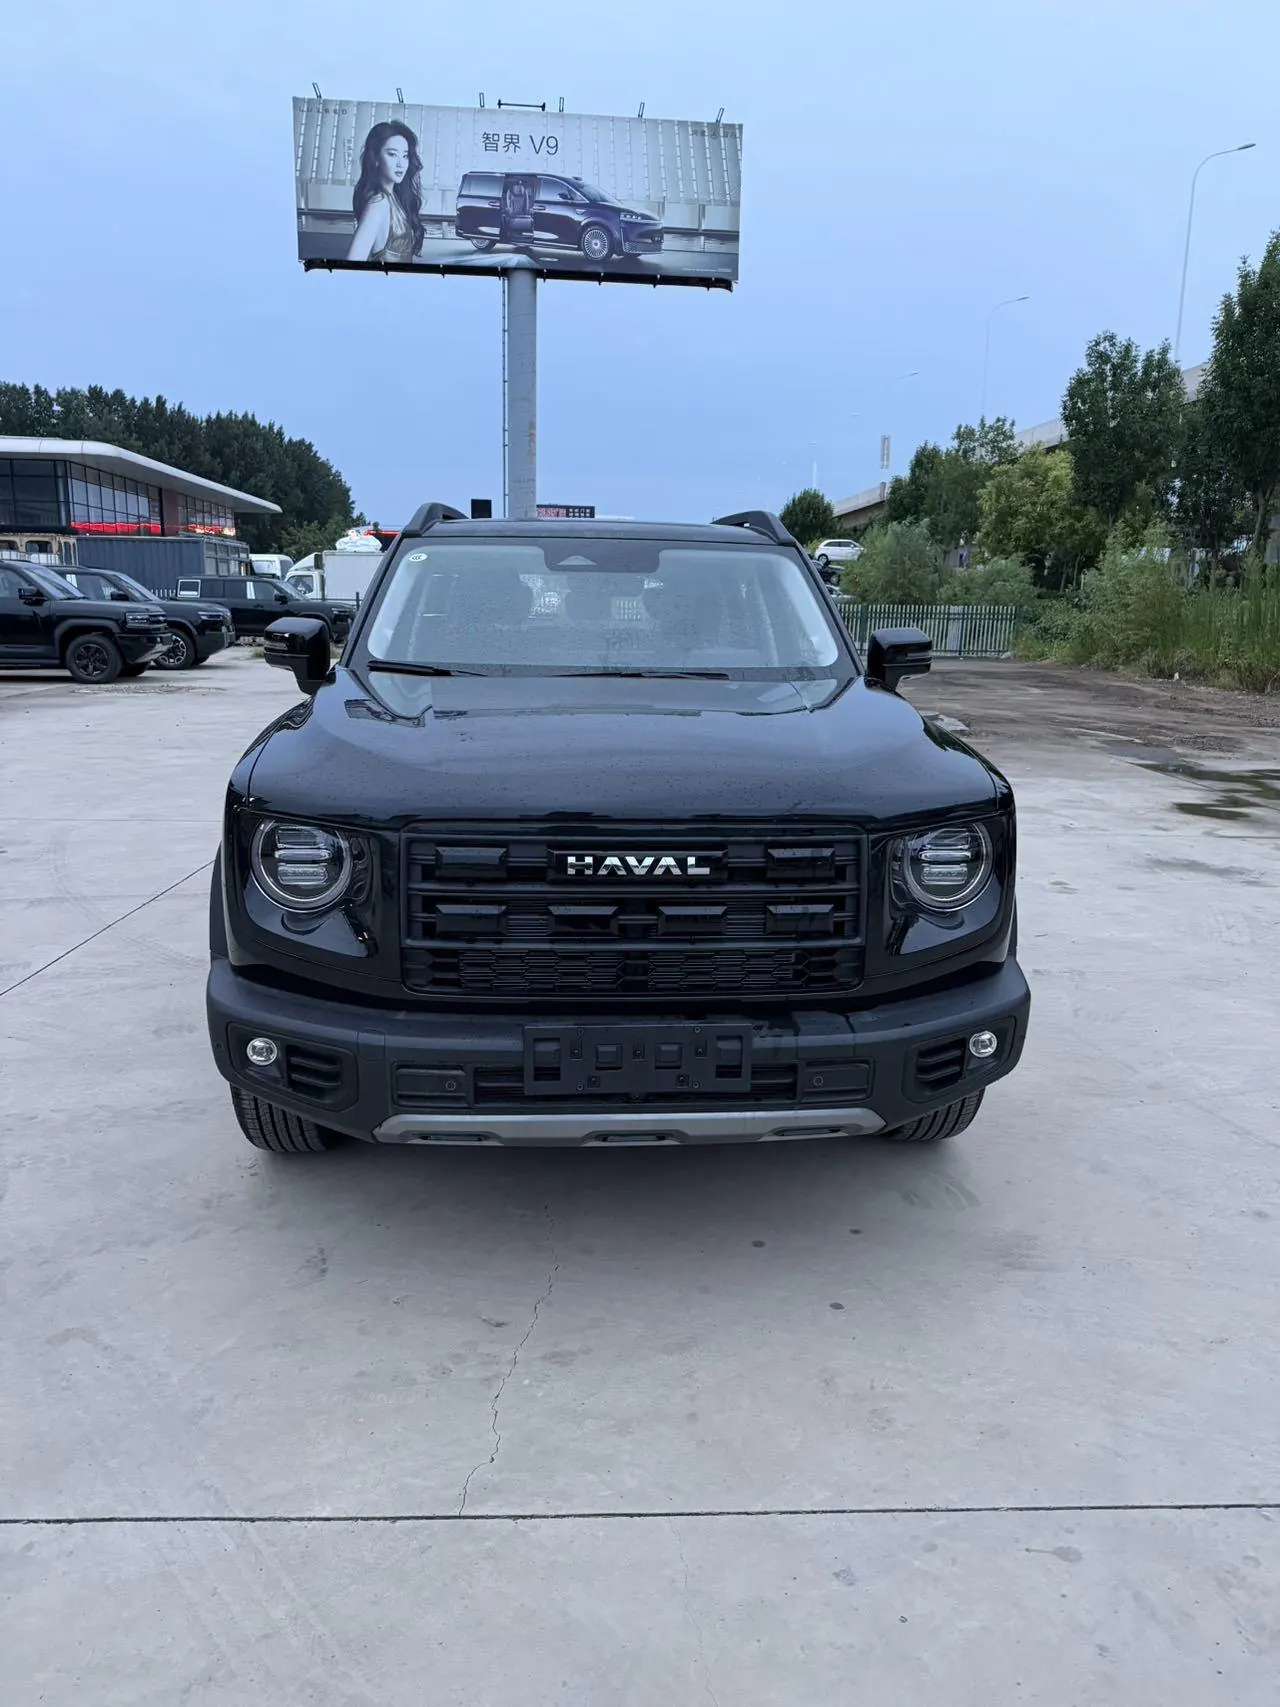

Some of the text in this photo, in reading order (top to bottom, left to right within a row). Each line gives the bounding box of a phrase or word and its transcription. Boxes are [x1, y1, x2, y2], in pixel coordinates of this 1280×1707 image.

[482, 131, 559, 155] 智界 V9
[567, 856, 711, 875] HAVAL
